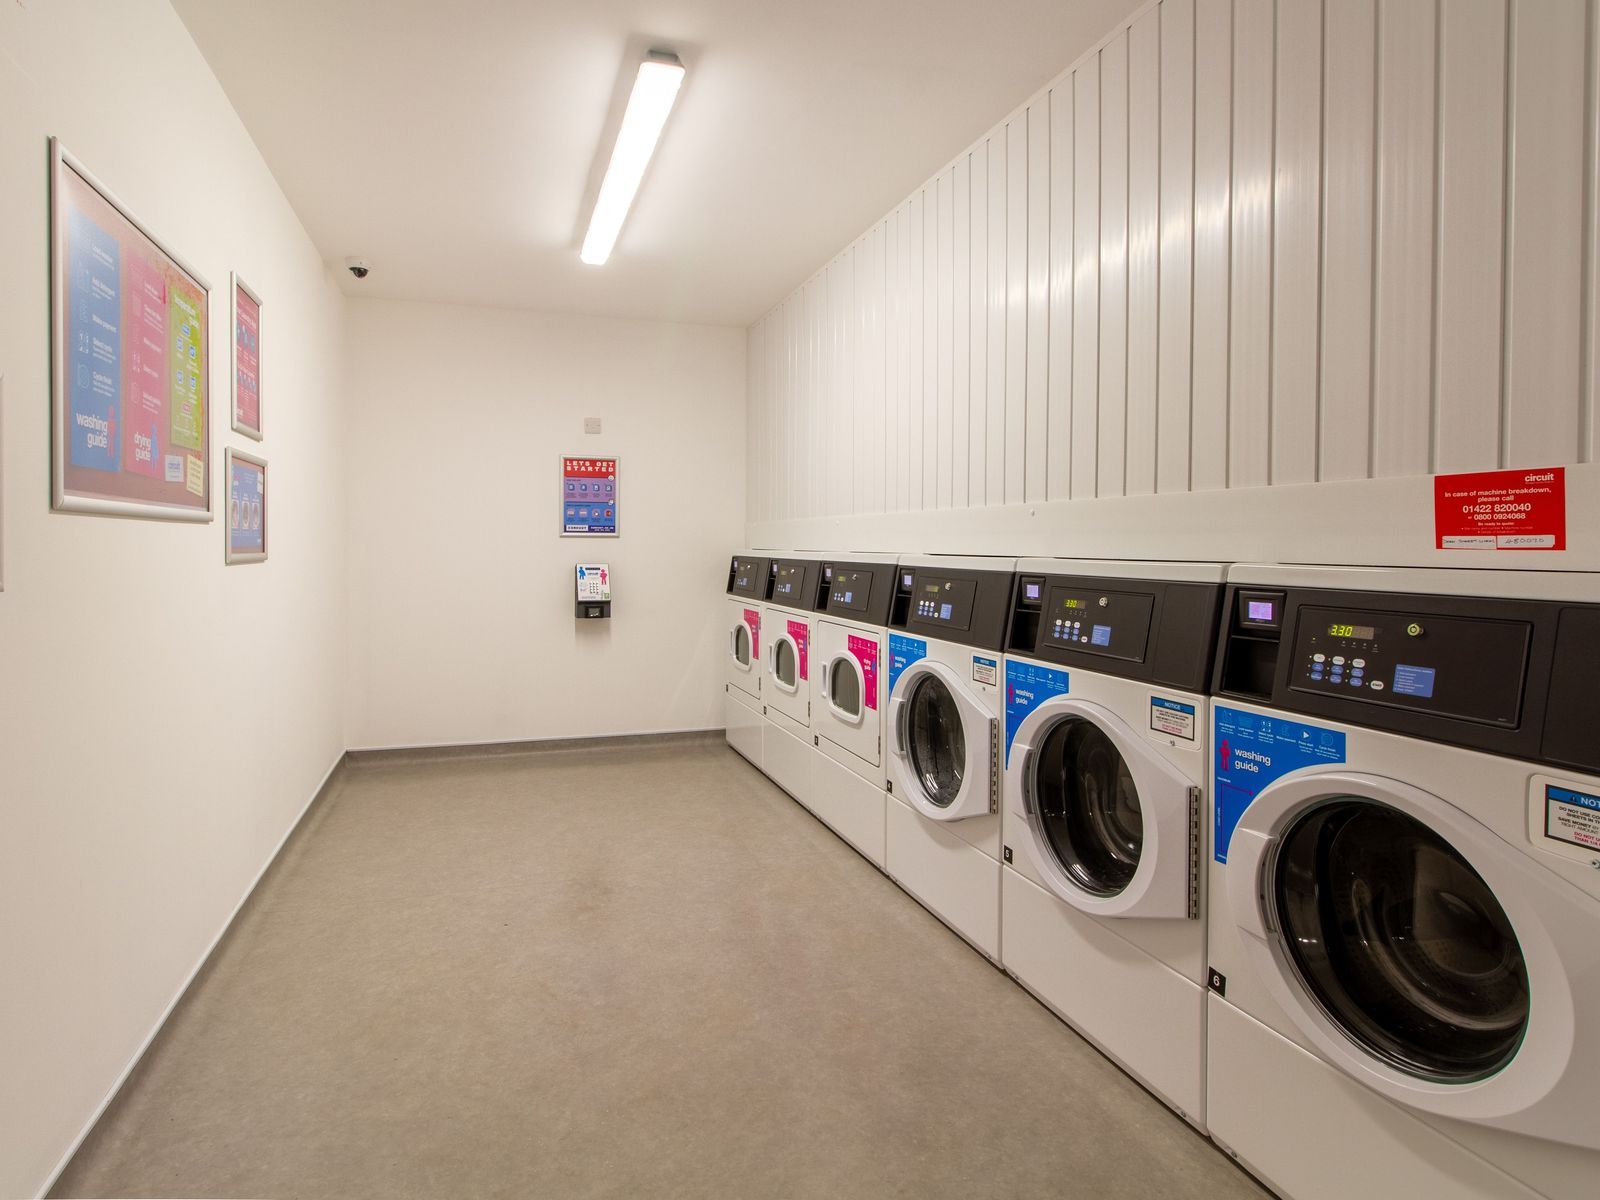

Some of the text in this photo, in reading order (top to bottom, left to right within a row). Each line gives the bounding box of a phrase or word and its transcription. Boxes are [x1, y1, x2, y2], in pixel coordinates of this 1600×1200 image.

[76, 412, 108, 435] washing
[88, 434, 107, 448] guide
[134, 432, 151, 449] drying
[136, 448, 150, 461] guide
[1524, 473, 1554, 482] circuit
[1462, 503, 1532, 513] 01422 820040
[1016, 689, 1034, 700] washing
[1016, 697, 1028, 705] guide
[1164, 702, 1180, 710] NOTICE
[1234, 748, 1271, 766] washing
[1234, 759, 1259, 773] guide
[1214, 975, 1220, 986] 6
